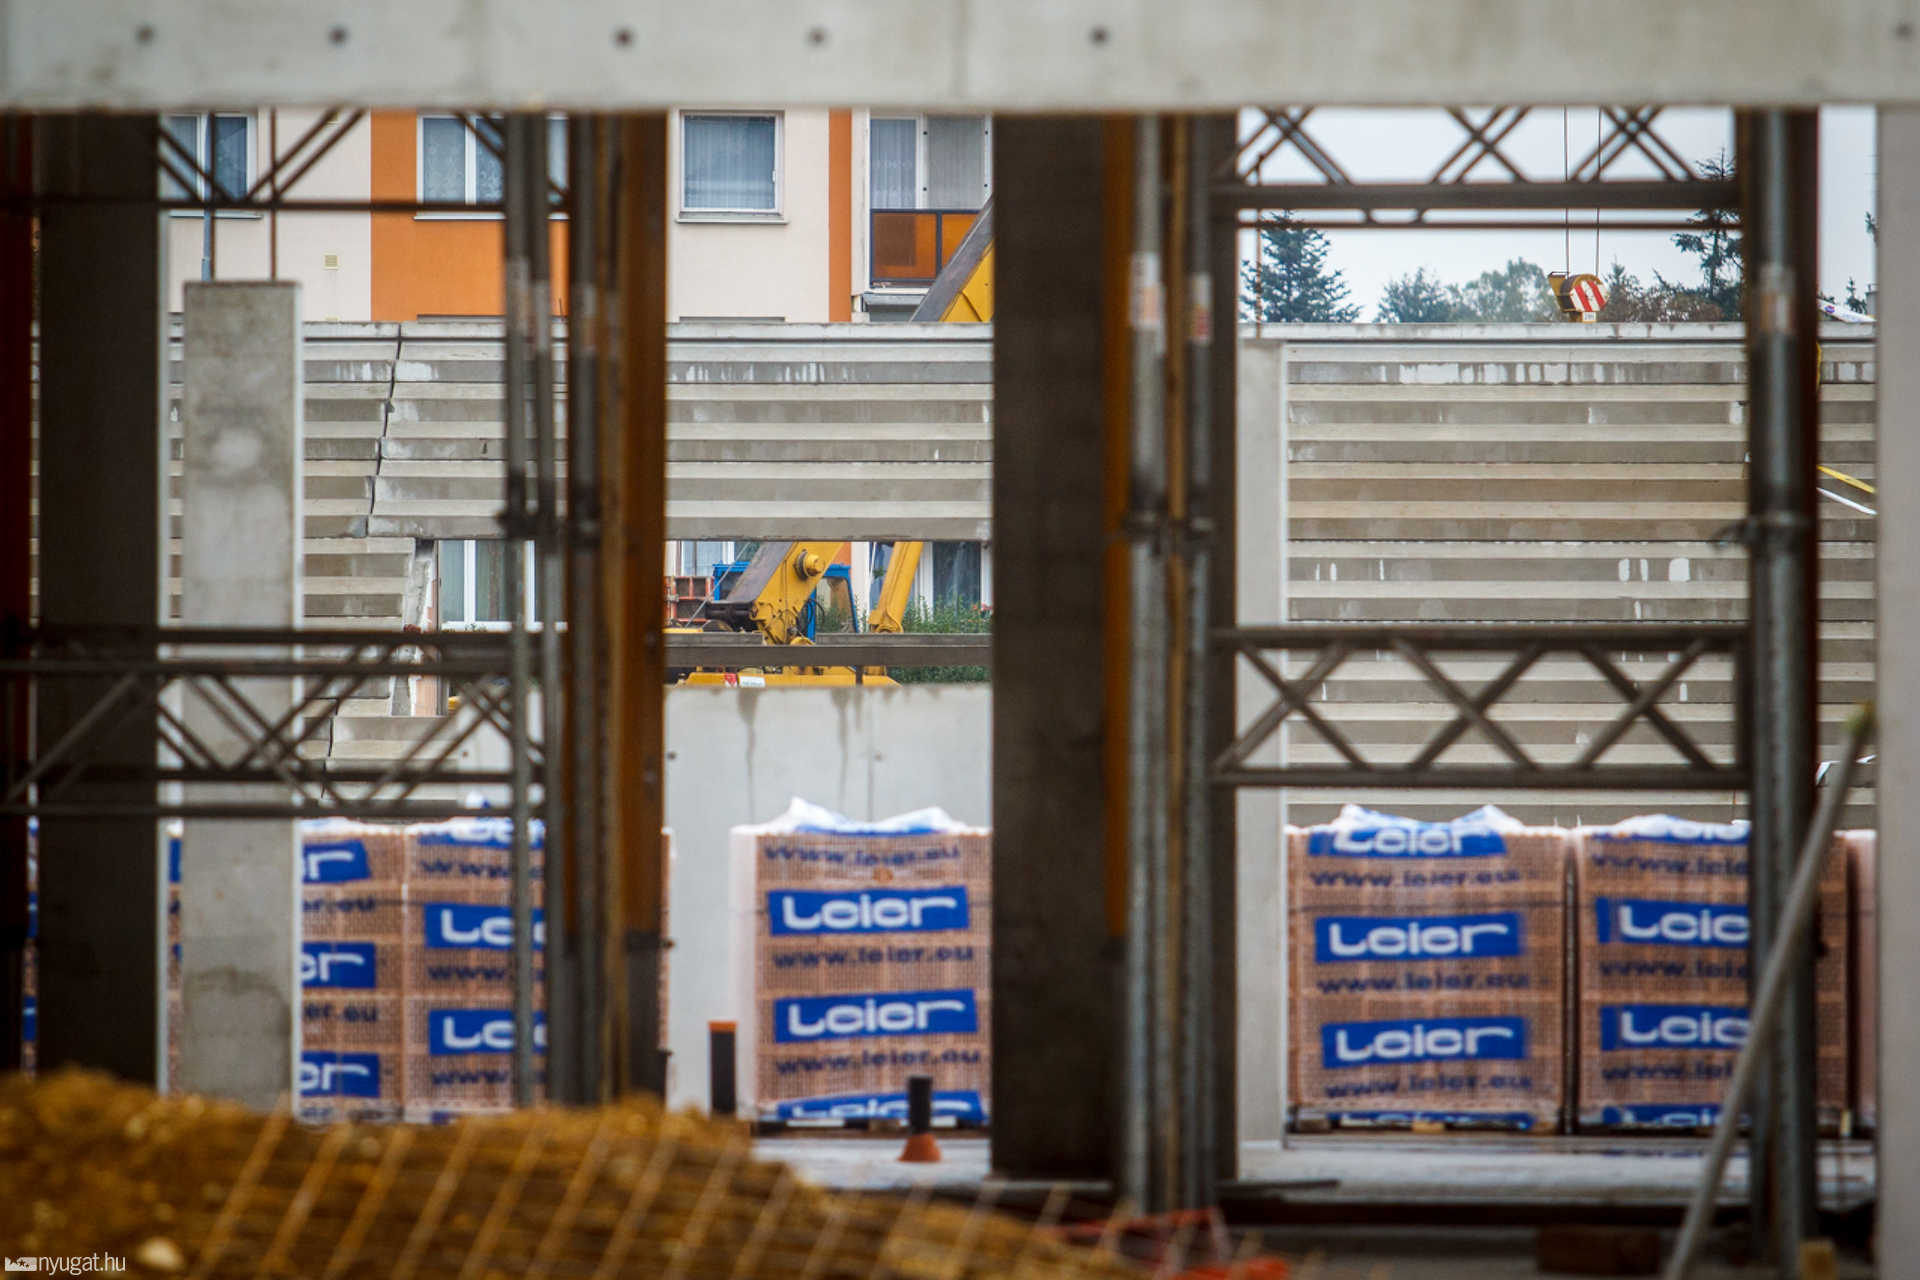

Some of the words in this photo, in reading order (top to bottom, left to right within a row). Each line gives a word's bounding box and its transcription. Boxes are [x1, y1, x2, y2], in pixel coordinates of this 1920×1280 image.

[782, 894, 957, 930] Leier
[1619, 905, 1749, 941] Leie
[1329, 921, 1509, 956] Leier
[788, 998, 966, 1036] Leier
[1620, 1010, 1751, 1044] Leie
[1336, 1024, 1514, 1062] Leier
